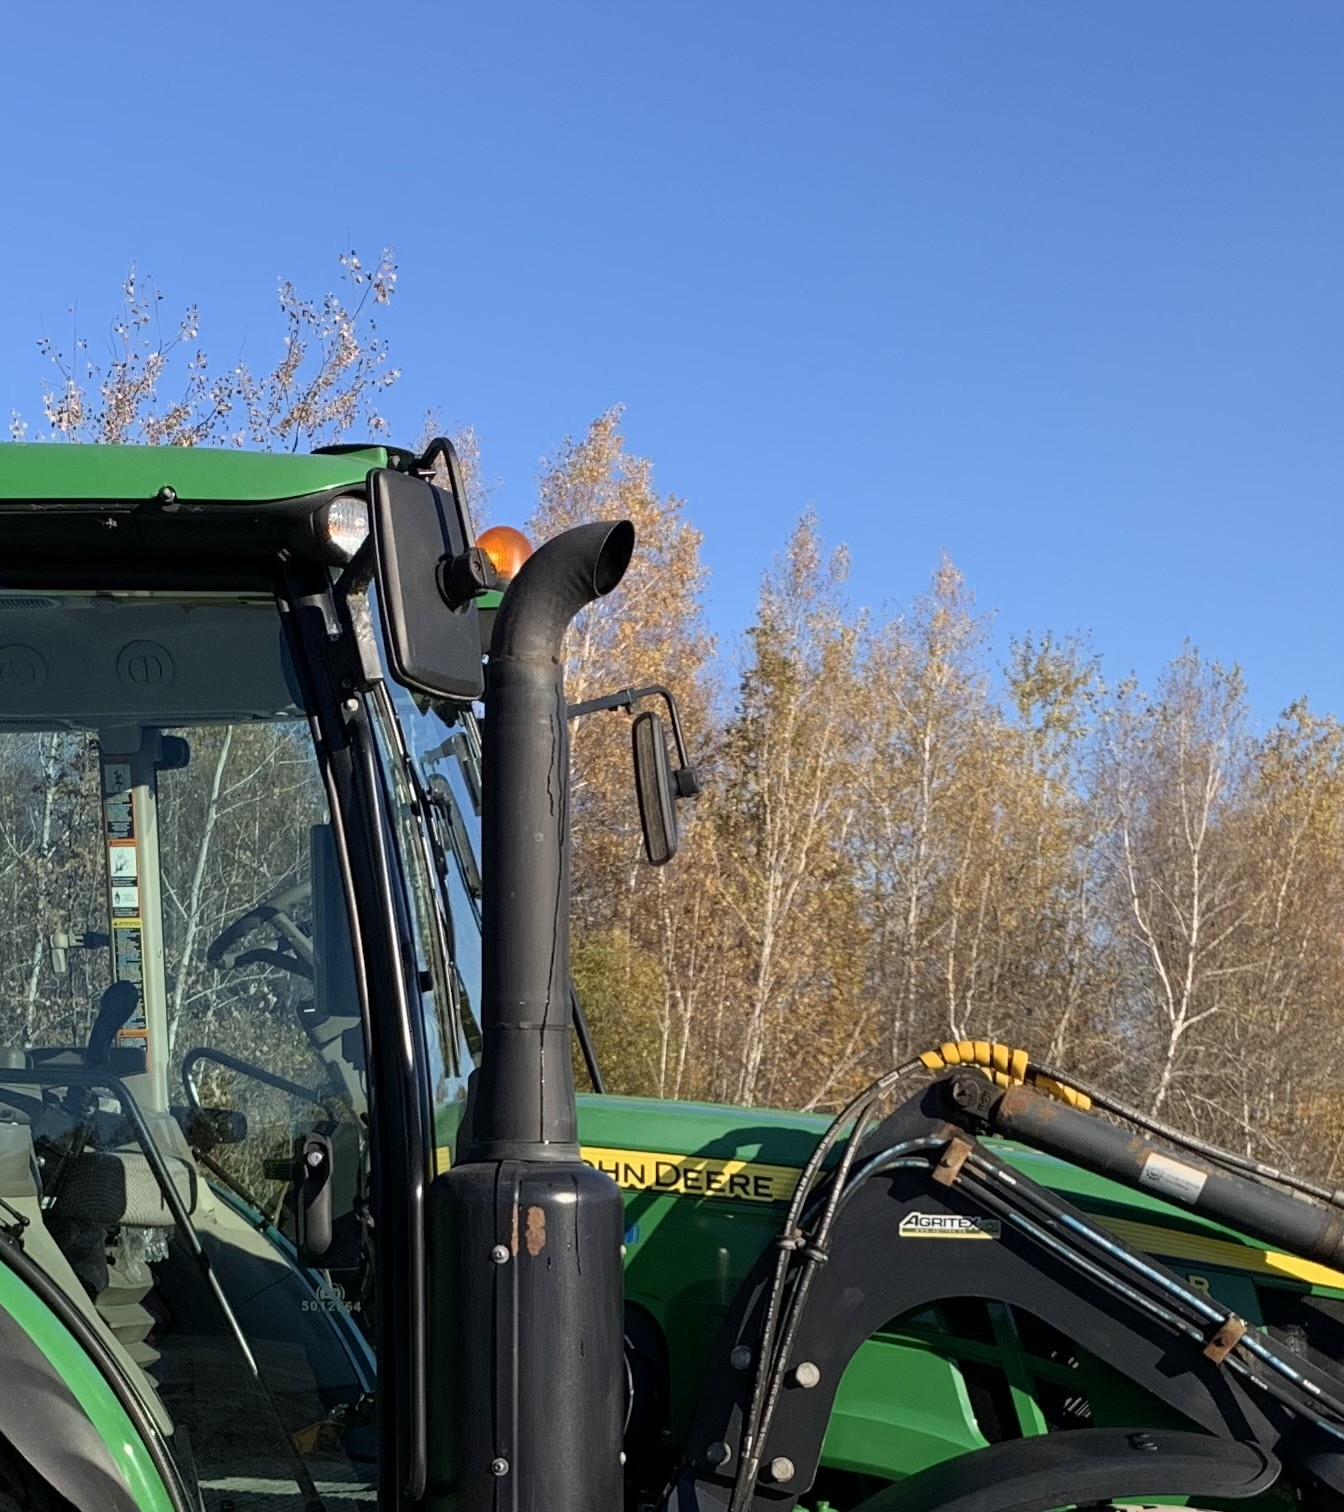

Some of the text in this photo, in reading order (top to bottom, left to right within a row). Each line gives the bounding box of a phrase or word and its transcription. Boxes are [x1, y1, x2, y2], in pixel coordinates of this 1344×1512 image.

[581, 1159, 774, 1198] HN DEERE
[903, 1214, 980, 1229] AGRITEX
